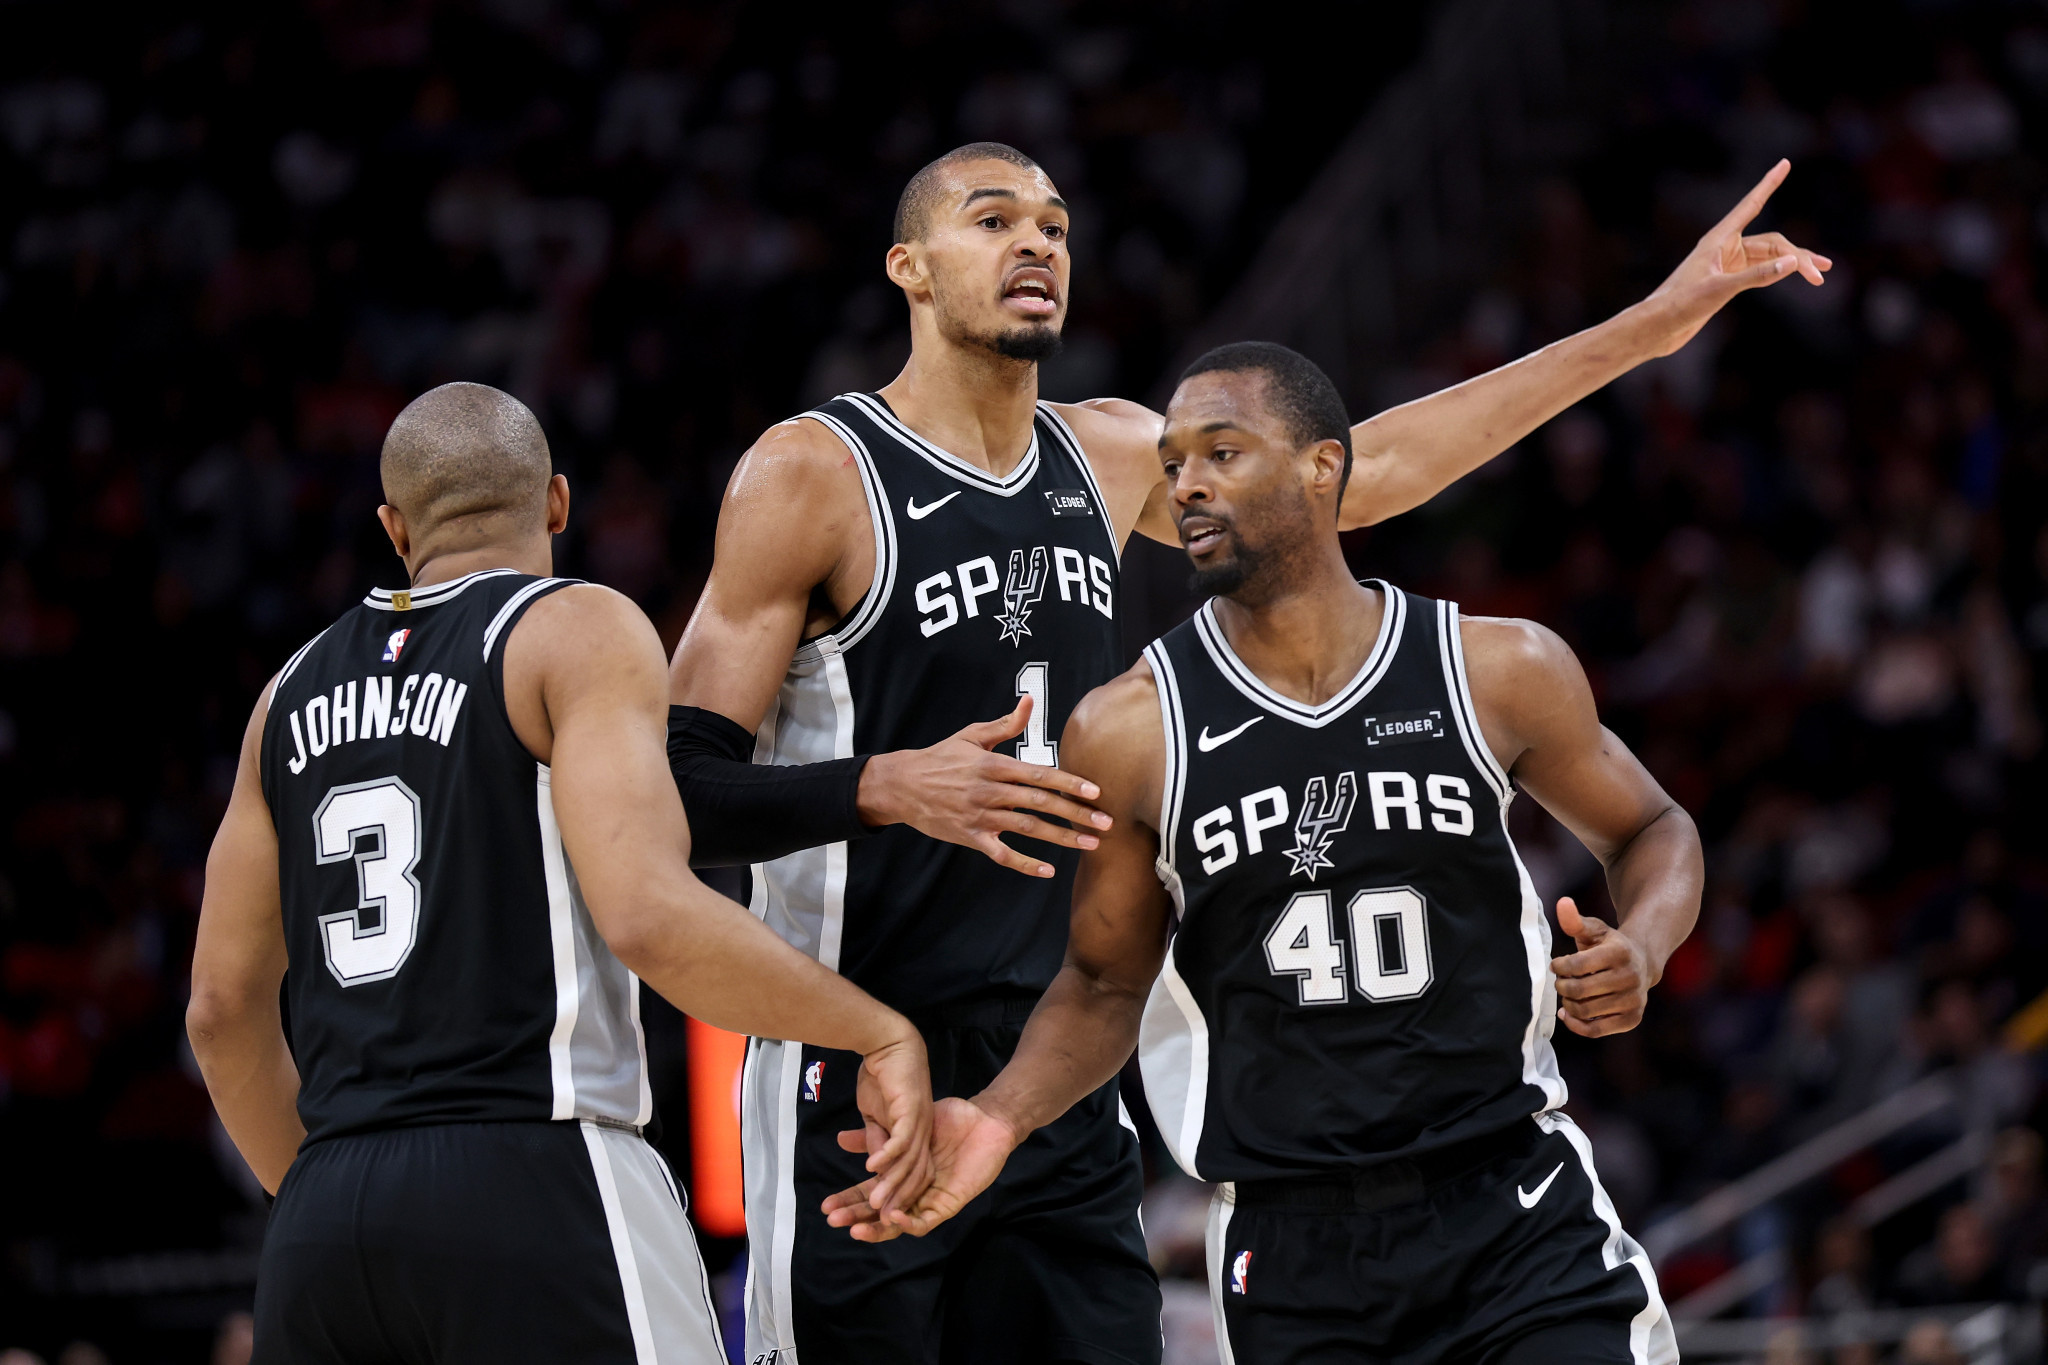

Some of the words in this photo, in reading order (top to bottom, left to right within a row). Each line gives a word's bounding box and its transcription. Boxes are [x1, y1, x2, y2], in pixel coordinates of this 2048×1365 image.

[1055, 497, 1087, 508] LEDGER
[914, 546, 1114, 648] SPURS
[287, 673, 468, 775] JOHNSON
[1015, 662, 1059, 769] 1
[1375, 719, 1434, 737] LEDGER
[1193, 771, 1475, 881] SPURS
[312, 775, 422, 989] 3
[1263, 885, 1435, 1006] 40
